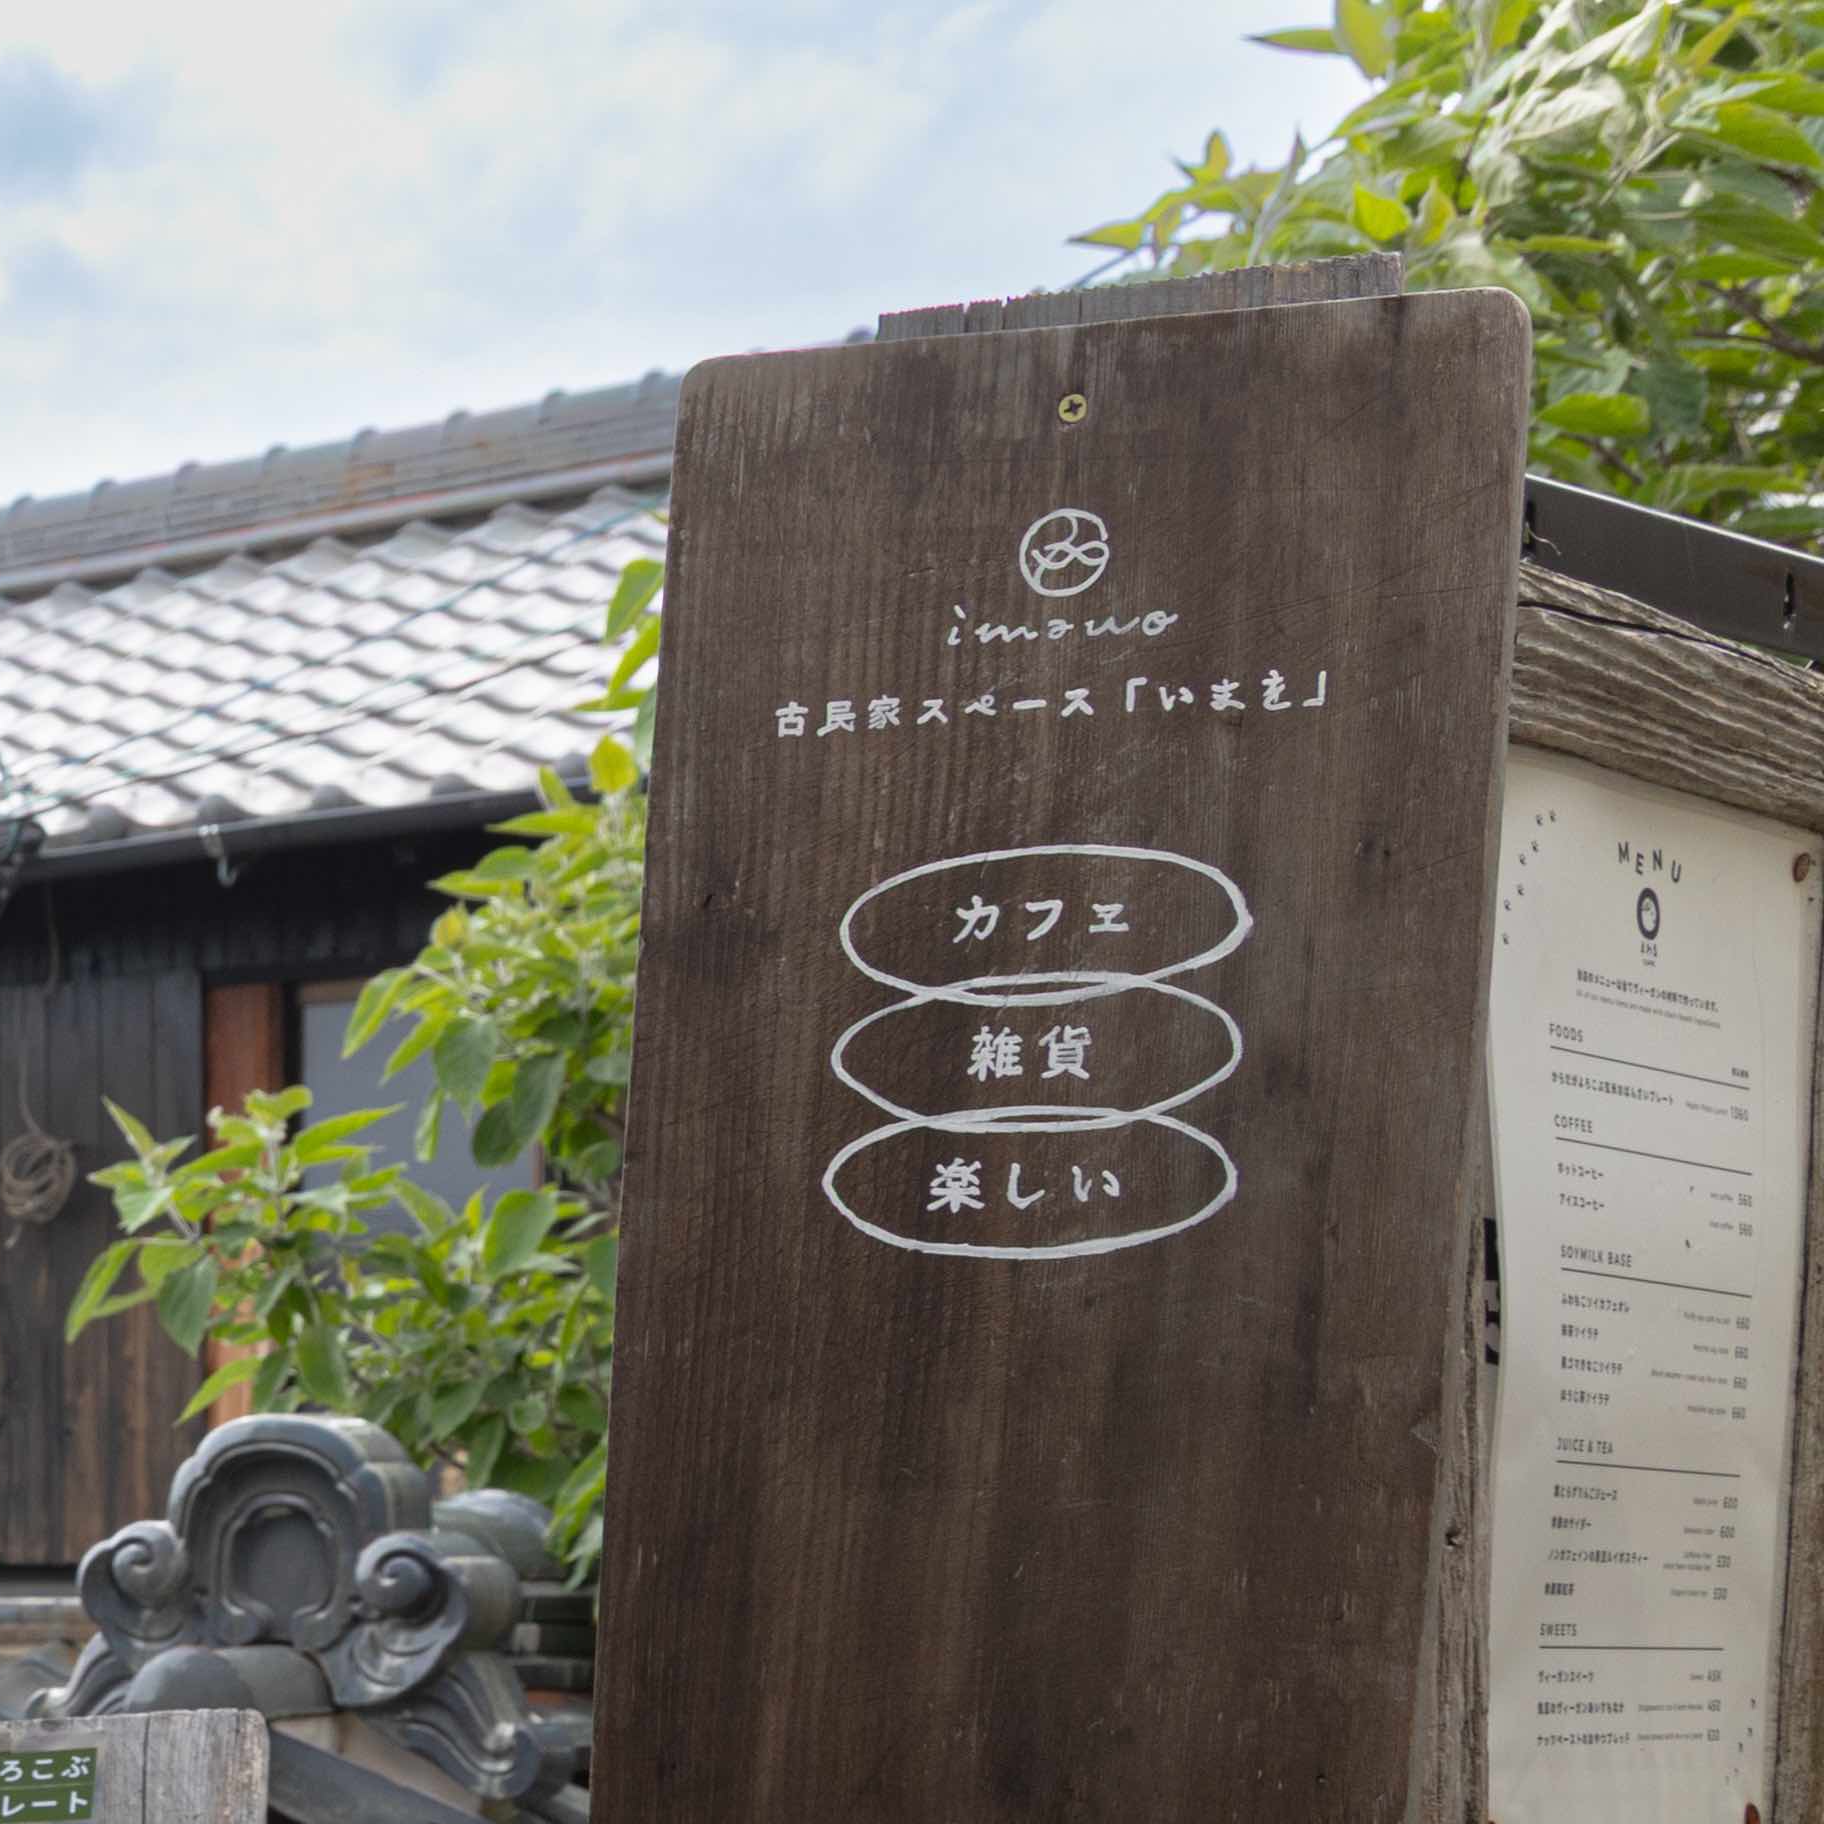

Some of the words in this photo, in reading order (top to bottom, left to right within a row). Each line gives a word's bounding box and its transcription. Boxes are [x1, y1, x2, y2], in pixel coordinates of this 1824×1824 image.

[774, 668, 1329, 740] 古民家スペース「いまを」
[1616, 839, 1683, 885] MENU
[1548, 1022, 1585, 1044] FOODS
[965, 1023, 1095, 1083] 雑貨
[1553, 1113, 1594, 1135] COFFEE
[925, 1156, 1123, 1215] 楽しい
[1559, 1245, 1604, 1265] SOYMILK
[1607, 1249, 1633, 1268] BASE
[1556, 1436, 1584, 1454] JUICE
[1595, 1438, 1615, 1456] TEA
[1538, 1621, 1579, 1639] SWEETS
